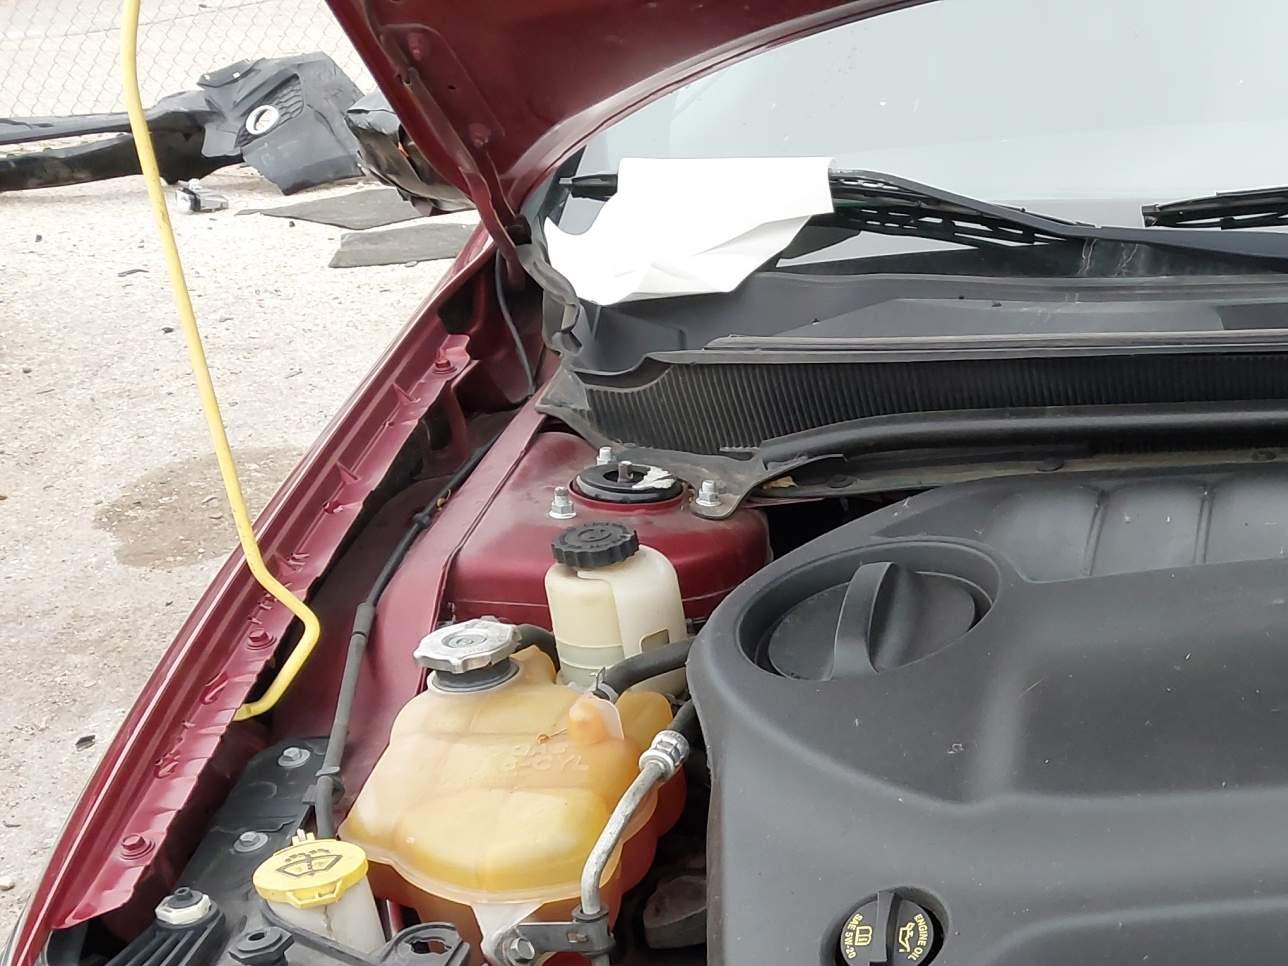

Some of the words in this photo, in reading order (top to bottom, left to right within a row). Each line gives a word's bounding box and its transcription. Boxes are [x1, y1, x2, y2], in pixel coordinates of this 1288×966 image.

[846, 913, 863, 931] SAE
[913, 913, 929, 947] ENGINE
[844, 931, 857, 959] 5W-20
[907, 946, 923, 961] OIL
